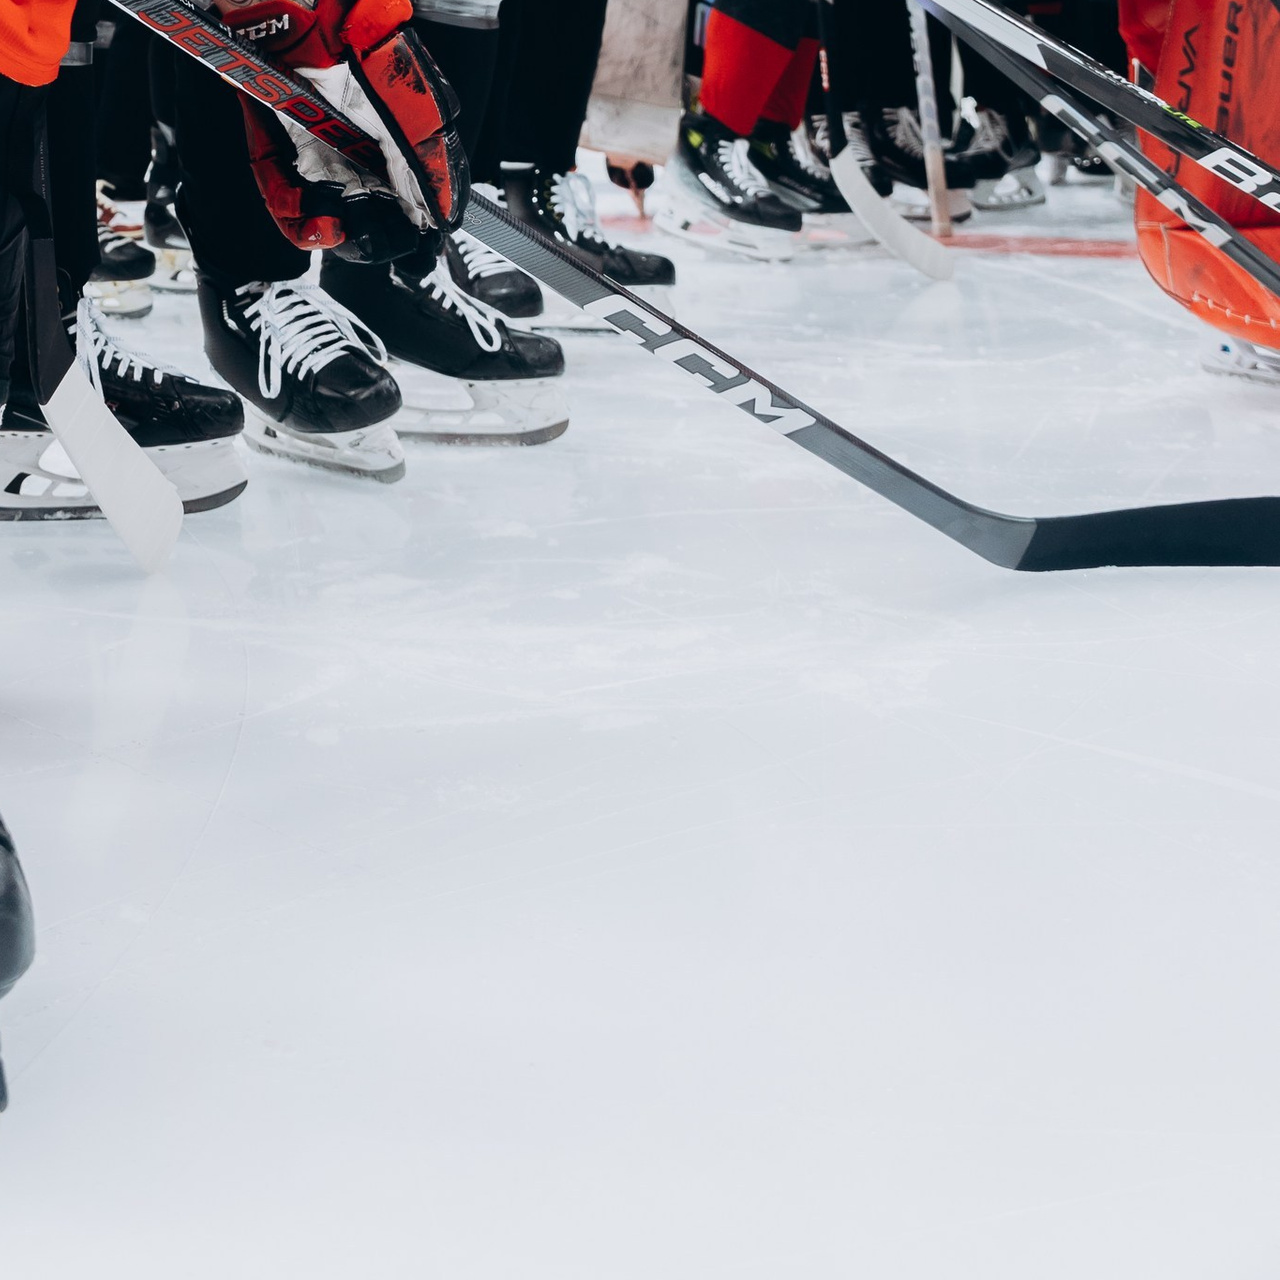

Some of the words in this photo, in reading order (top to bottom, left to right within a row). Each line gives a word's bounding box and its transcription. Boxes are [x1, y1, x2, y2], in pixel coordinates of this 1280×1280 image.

[139, 7, 383, 168] JETSPEE
[1214, 1, 1244, 138] AUER
[1040, 95, 1233, 247] CCM
[583, 293, 818, 437] CCM
